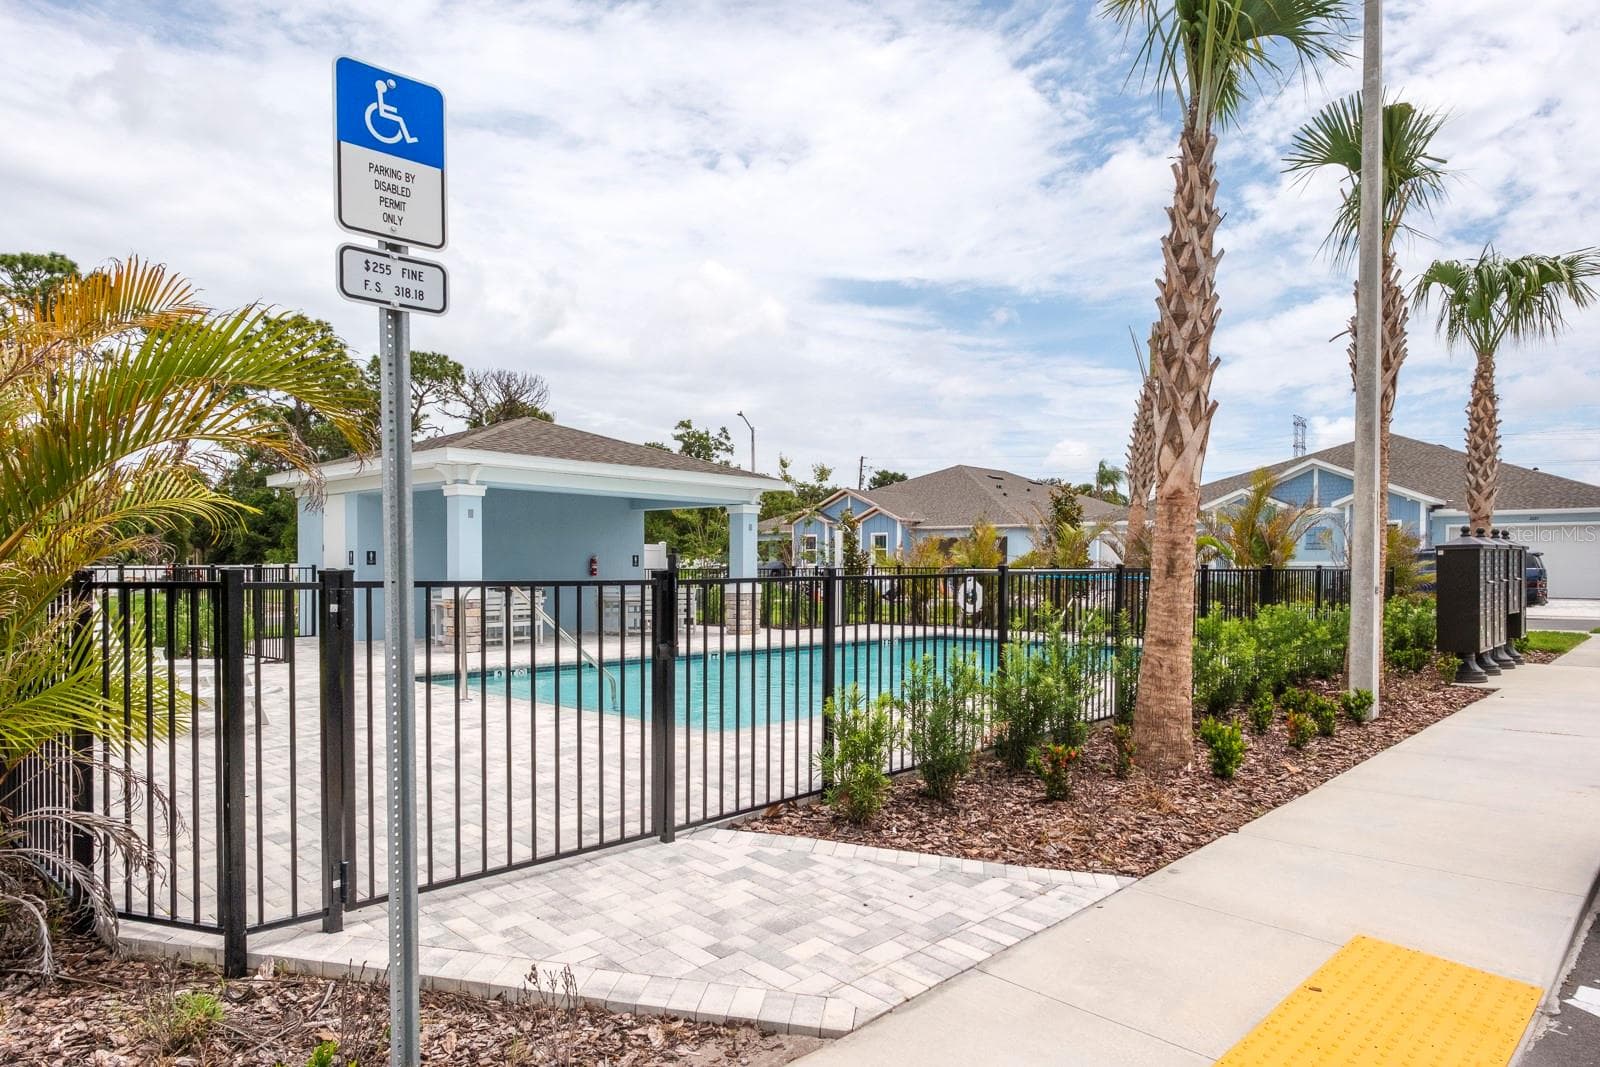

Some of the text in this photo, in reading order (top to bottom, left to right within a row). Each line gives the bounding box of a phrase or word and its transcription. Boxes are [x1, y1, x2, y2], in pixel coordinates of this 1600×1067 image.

[368, 162, 416, 183] PARKING BY
[374, 179, 411, 198] DISABLED
[379, 195, 407, 212] PERMIT
[382, 212, 404, 226] ONLY
[364, 259, 424, 282] $255 FINE
[394, 285, 424, 301] 318.18
